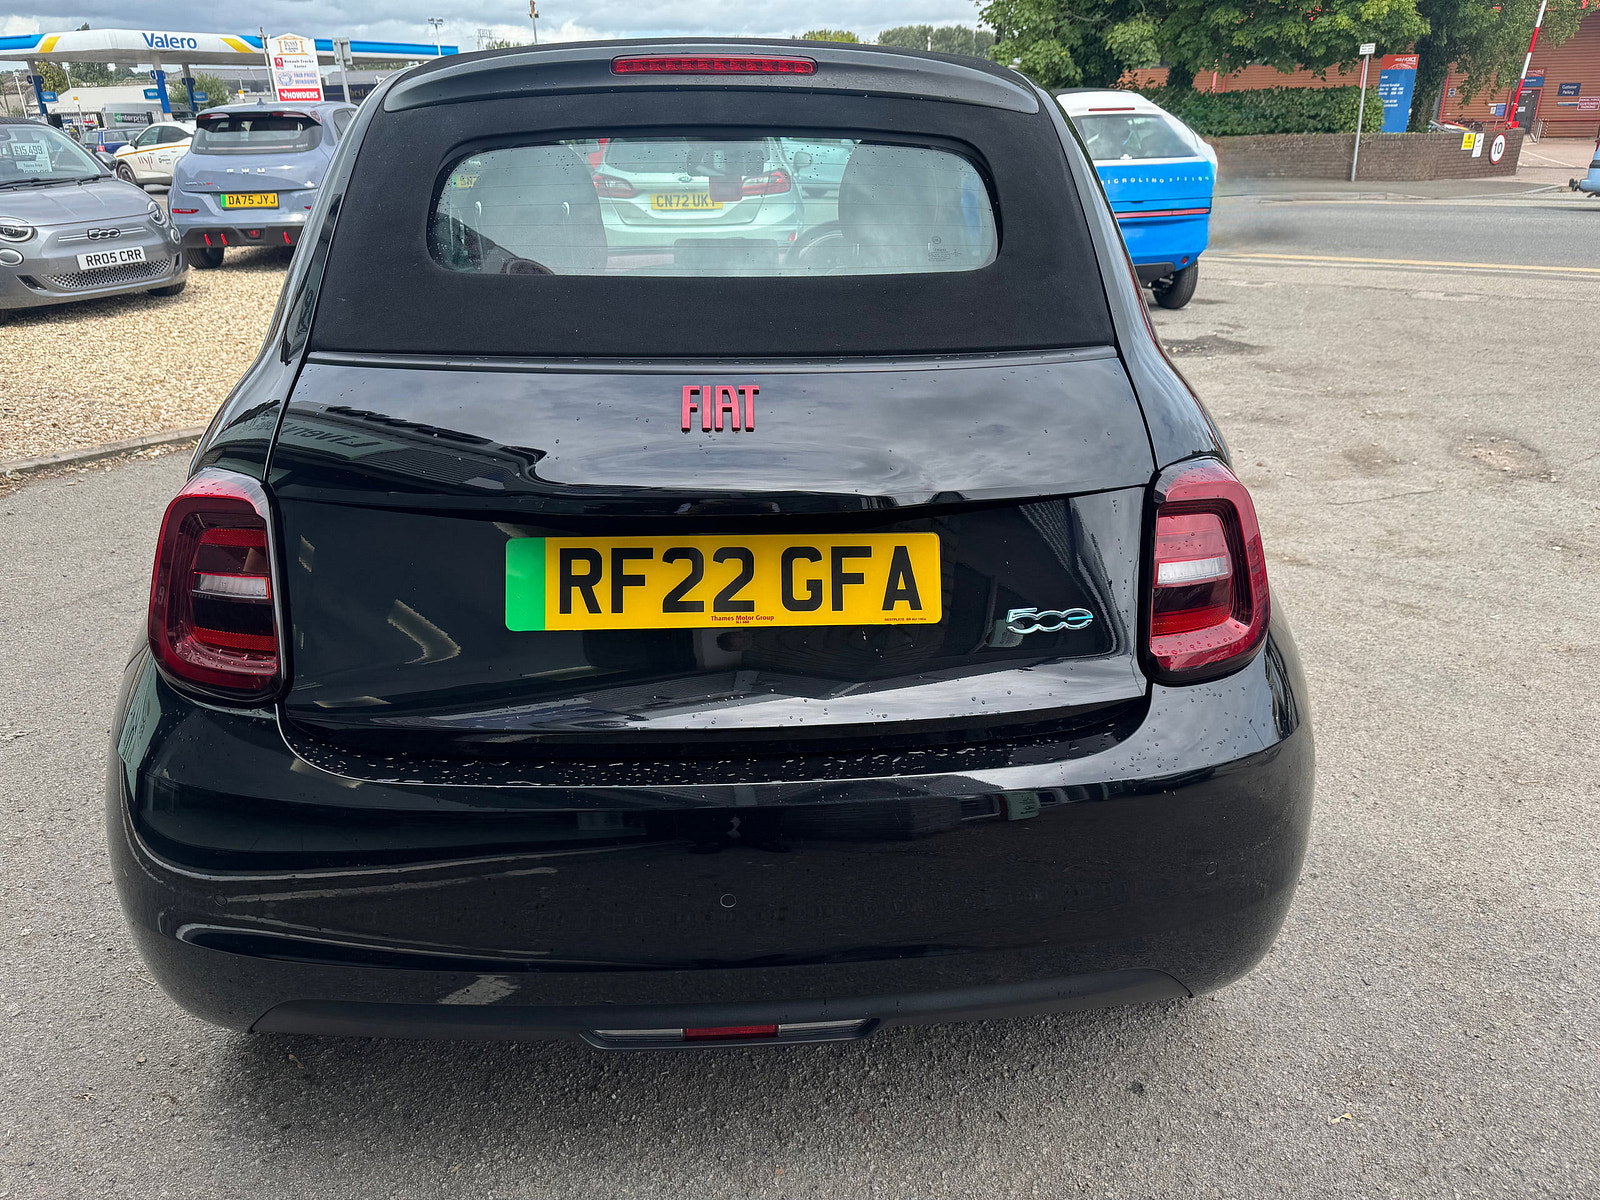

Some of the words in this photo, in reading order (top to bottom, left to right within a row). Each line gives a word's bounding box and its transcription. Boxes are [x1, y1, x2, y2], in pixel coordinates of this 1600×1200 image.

[142, 32, 197, 49] Valero
[287, 91, 319, 99] HOWDENS
[1493, 142, 1503, 155] 10
[228, 195, 254, 205] DA75
[257, 194, 277, 204] JYJ
[656, 194, 690, 208] CN72
[87, 227, 121, 241] 500
[85, 252, 118, 267] RR05
[119, 249, 143, 262] CRR
[681, 385, 760, 432] FIAT
[559, 546, 755, 614] RF22
[780, 545, 923, 612] GFA
[755, 614, 775, 622] Group
